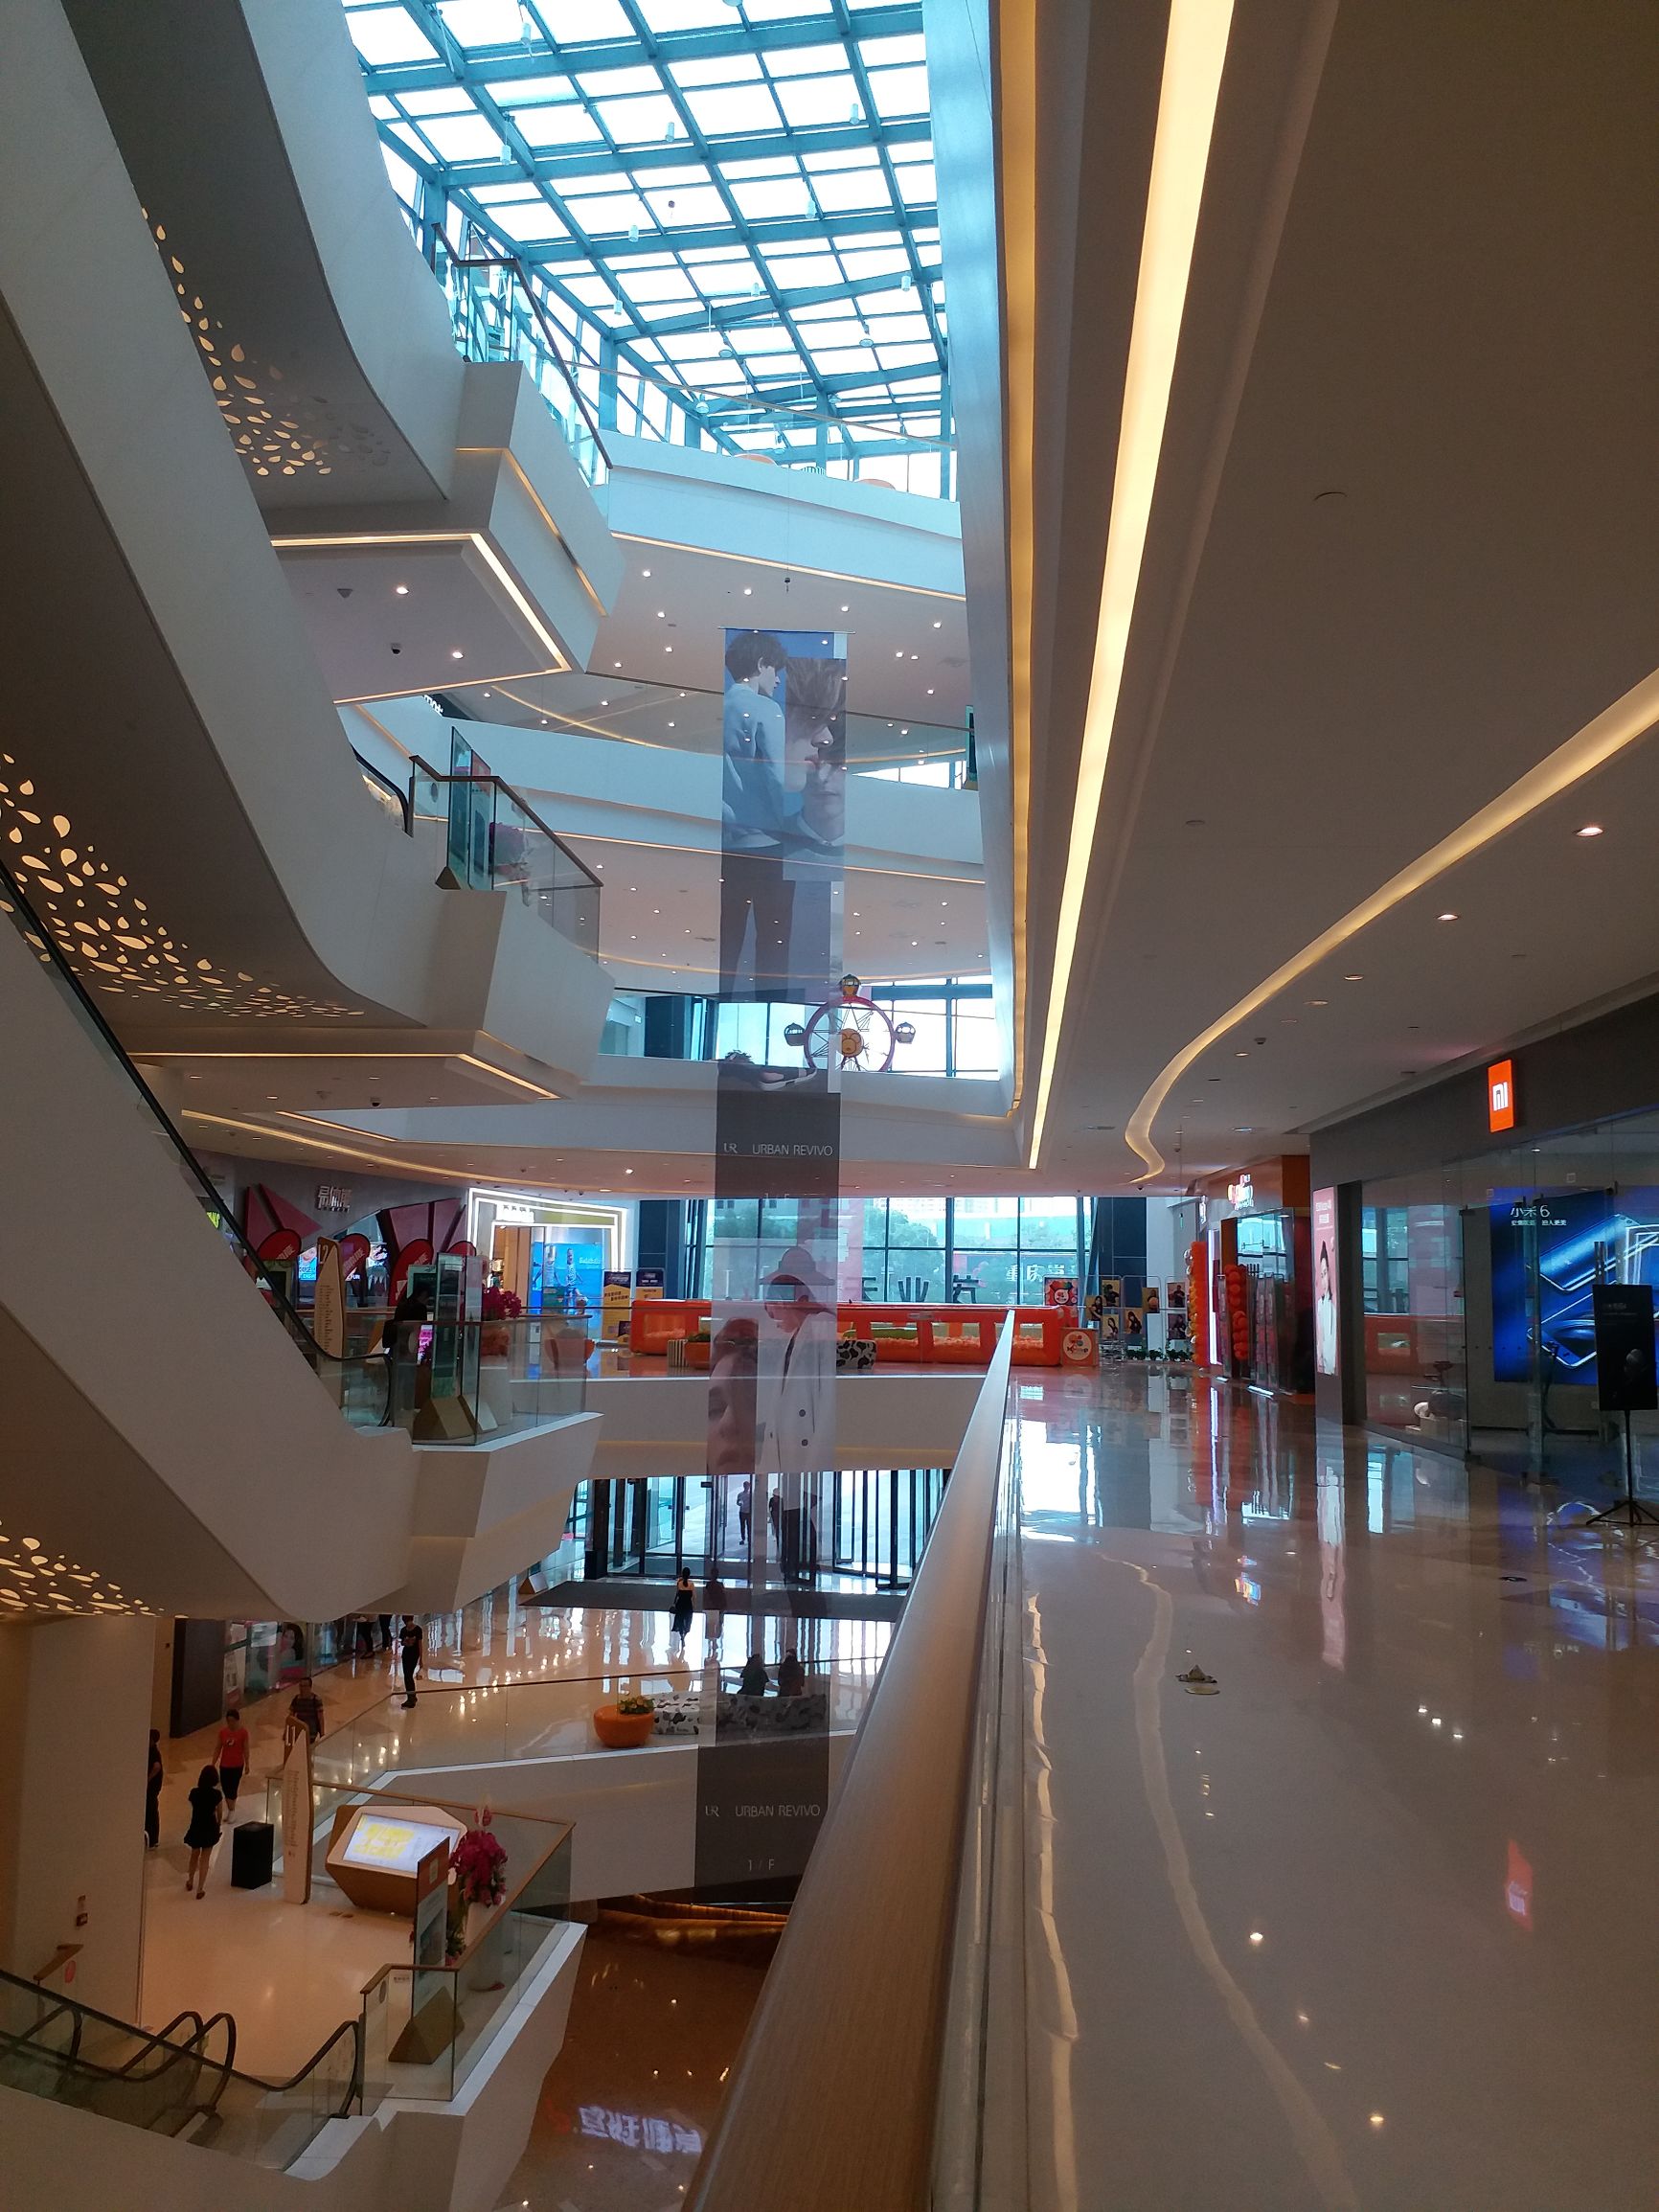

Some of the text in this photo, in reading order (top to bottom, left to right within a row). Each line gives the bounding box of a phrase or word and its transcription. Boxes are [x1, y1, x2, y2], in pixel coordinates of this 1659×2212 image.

[752, 1143, 789, 1155] URBAN
[793, 1145, 833, 1156] REVIVO
[1539, 1204, 1551, 1218] 6
[735, 1805, 774, 1817] URBAN
[778, 1804, 821, 1817] REVIVO
